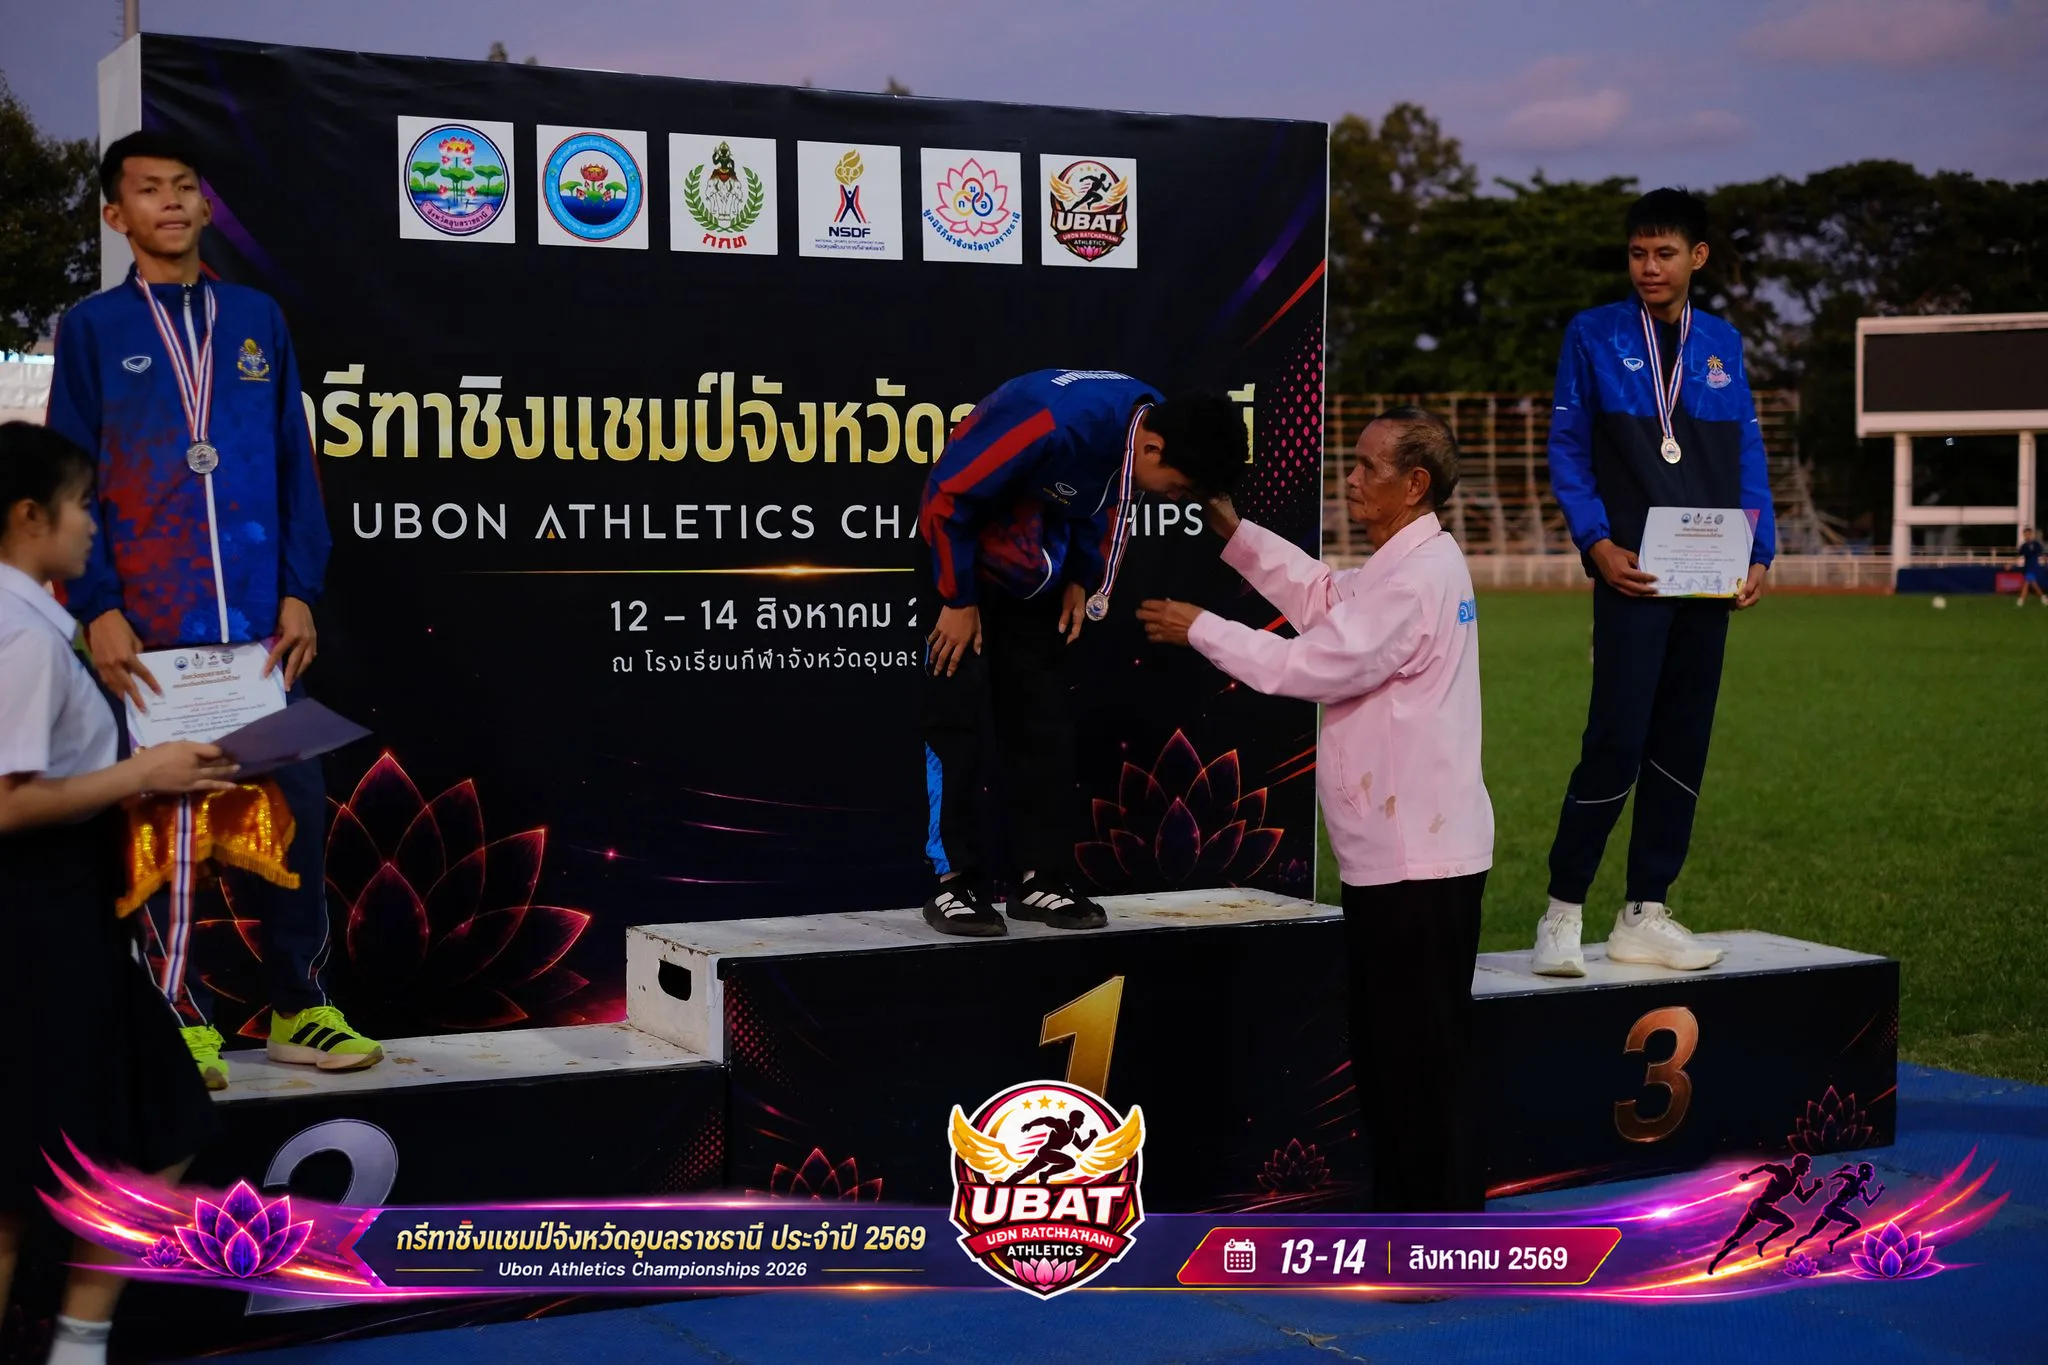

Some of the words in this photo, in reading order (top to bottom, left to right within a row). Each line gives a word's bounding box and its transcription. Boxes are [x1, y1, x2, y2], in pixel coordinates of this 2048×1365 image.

[828, 226, 871, 238] NSDF
[1056, 211, 1122, 233] UBAT
[353, 502, 506, 539] UBON
[534, 503, 815, 539] ATHLETICS
[610, 600, 648, 632] 12
[701, 600, 738, 631] 14
[756, 597, 891, 630] สิงหาคม
[612, 656, 633, 673] ณ
[1039, 975, 1126, 1099] 1
[1614, 1006, 1700, 1143] 3
